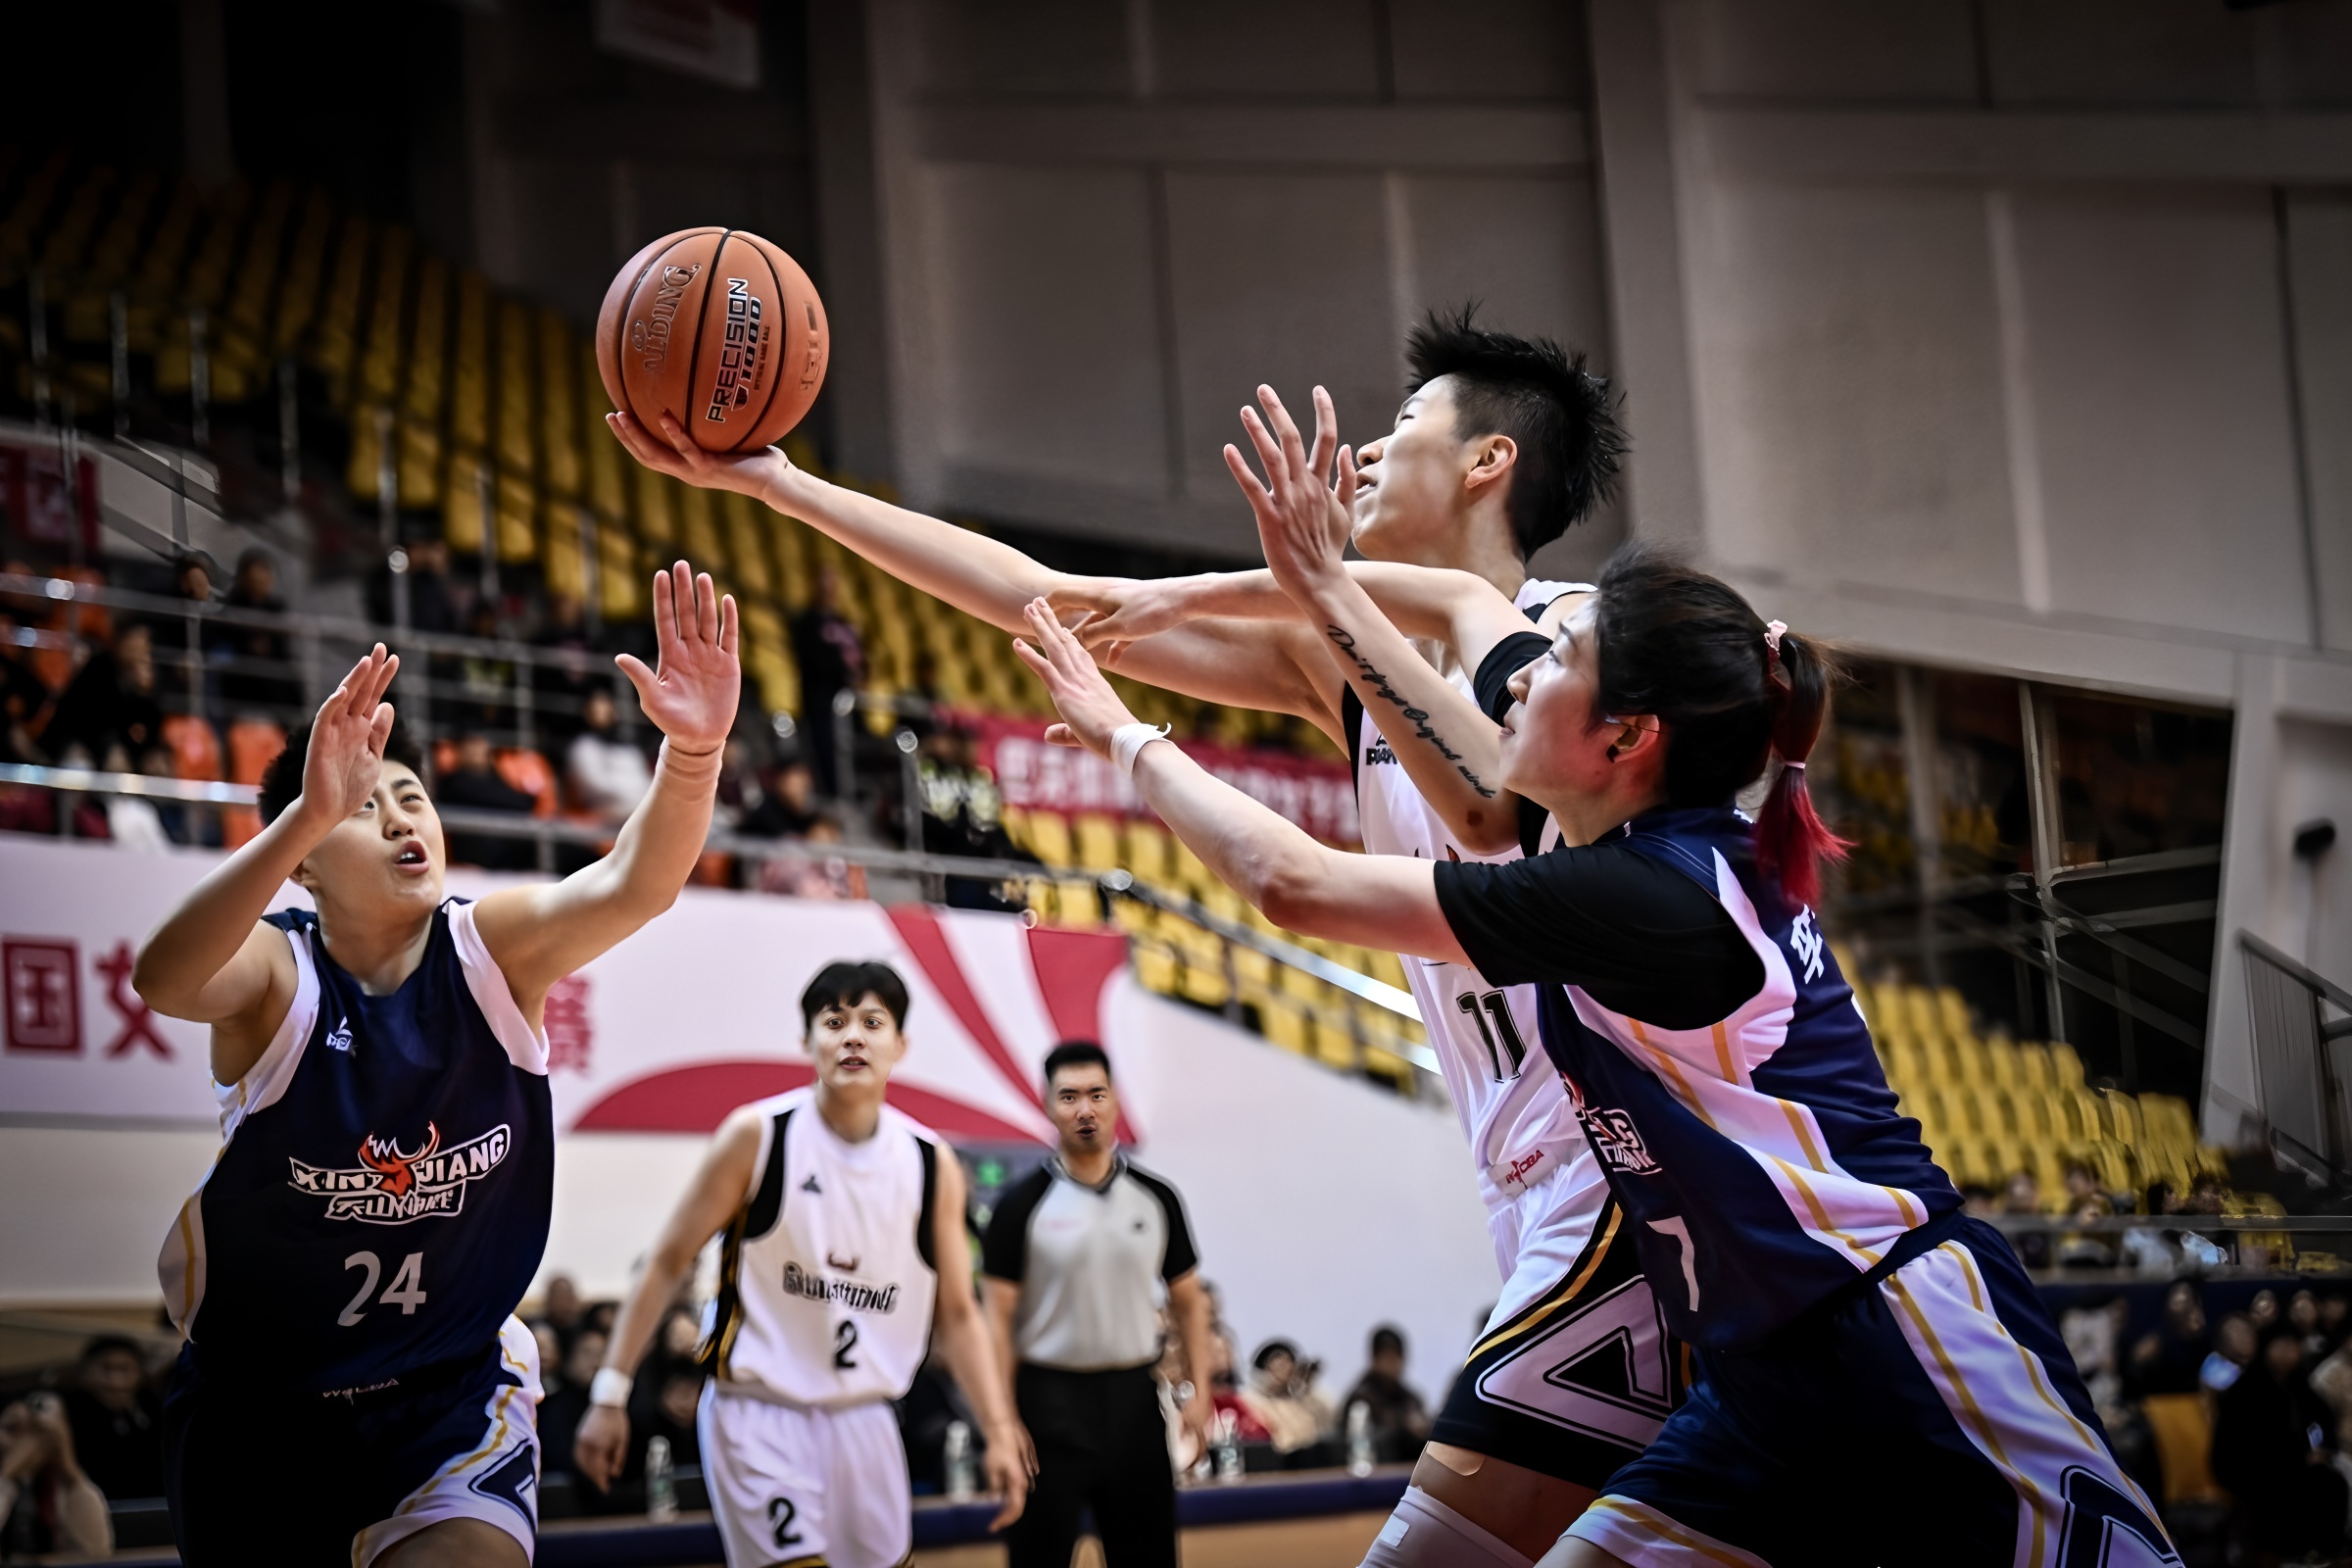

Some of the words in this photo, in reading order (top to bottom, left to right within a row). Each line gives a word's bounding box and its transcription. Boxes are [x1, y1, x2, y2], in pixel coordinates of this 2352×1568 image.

[706, 277, 749, 423] PRECISION
[1455, 988, 1528, 1084] 11
[337, 1250, 427, 1327] 24
[1646, 1215, 1699, 1312] 7
[833, 1319, 858, 1370] 2
[767, 1496, 804, 1548] 2
